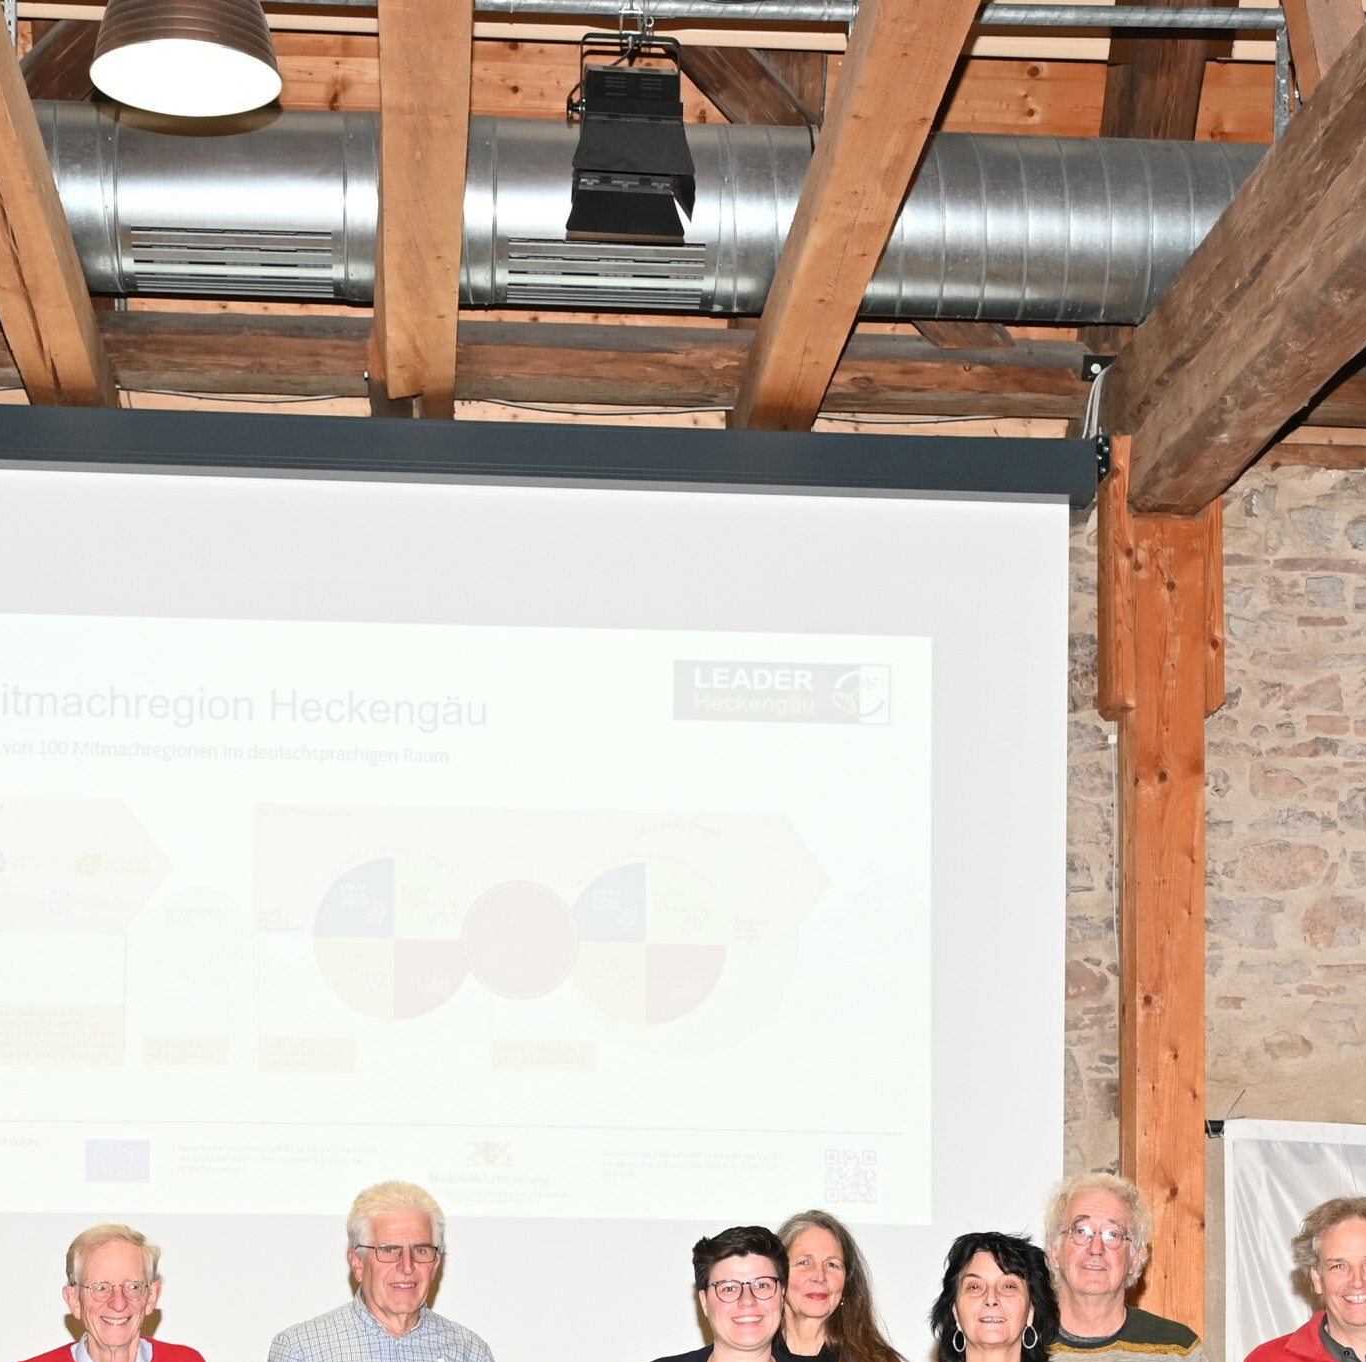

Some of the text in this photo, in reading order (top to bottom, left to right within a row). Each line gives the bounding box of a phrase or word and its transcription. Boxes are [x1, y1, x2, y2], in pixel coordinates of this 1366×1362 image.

[694, 667, 814, 691] LEADER
[269, 687, 488, 734] Heckengäu
[694, 693, 815, 717] Heckengäu
[2, 742, 33, 755] von
[38, 740, 68, 755] 100
[72, 740, 219, 762] Mitmachregionen
[223, 744, 244, 760] im
[247, 744, 398, 765] deutschsprachigen
[402, 748, 450, 764] Raum
